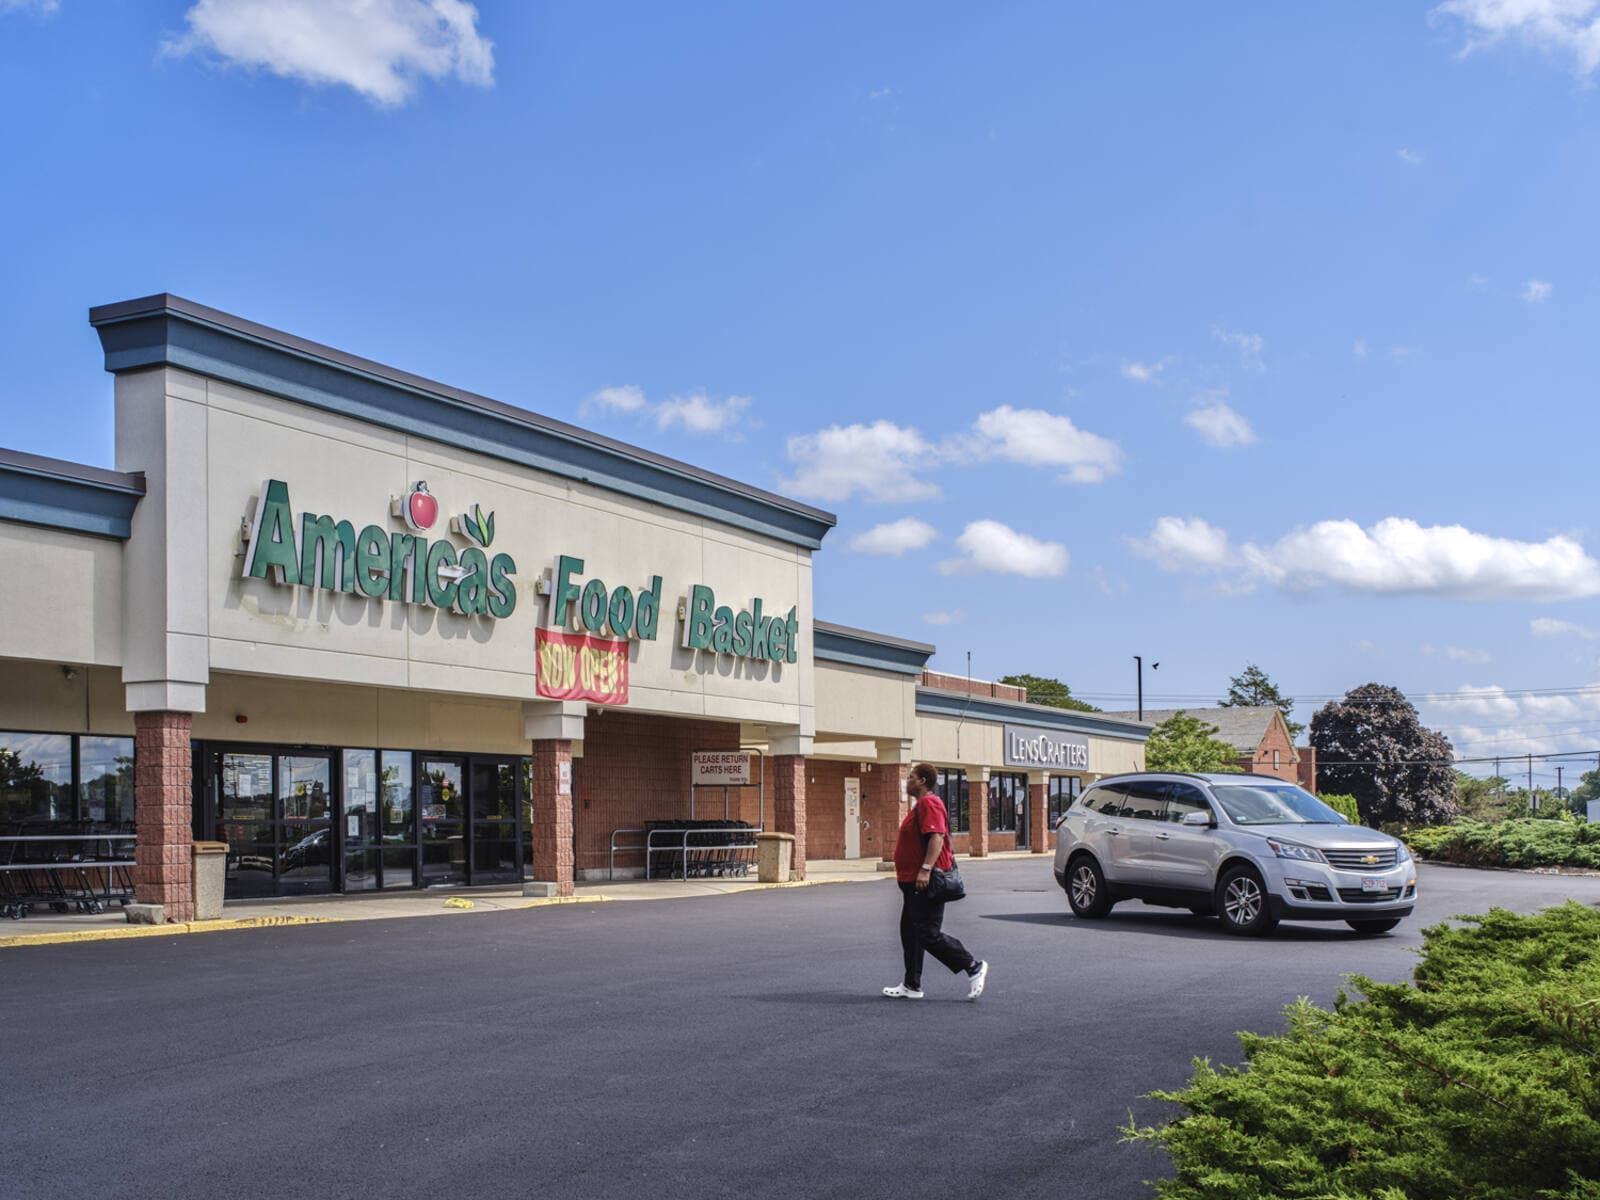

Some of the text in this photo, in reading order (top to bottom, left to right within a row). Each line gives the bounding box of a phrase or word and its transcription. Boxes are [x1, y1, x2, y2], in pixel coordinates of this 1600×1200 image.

[243, 479, 799, 664] Americas Food Basket
[540, 639, 625, 694] NOW OPEN!
[694, 755, 748, 763] PLEASE RETURN
[701, 766, 742, 774] CARTS HERE
